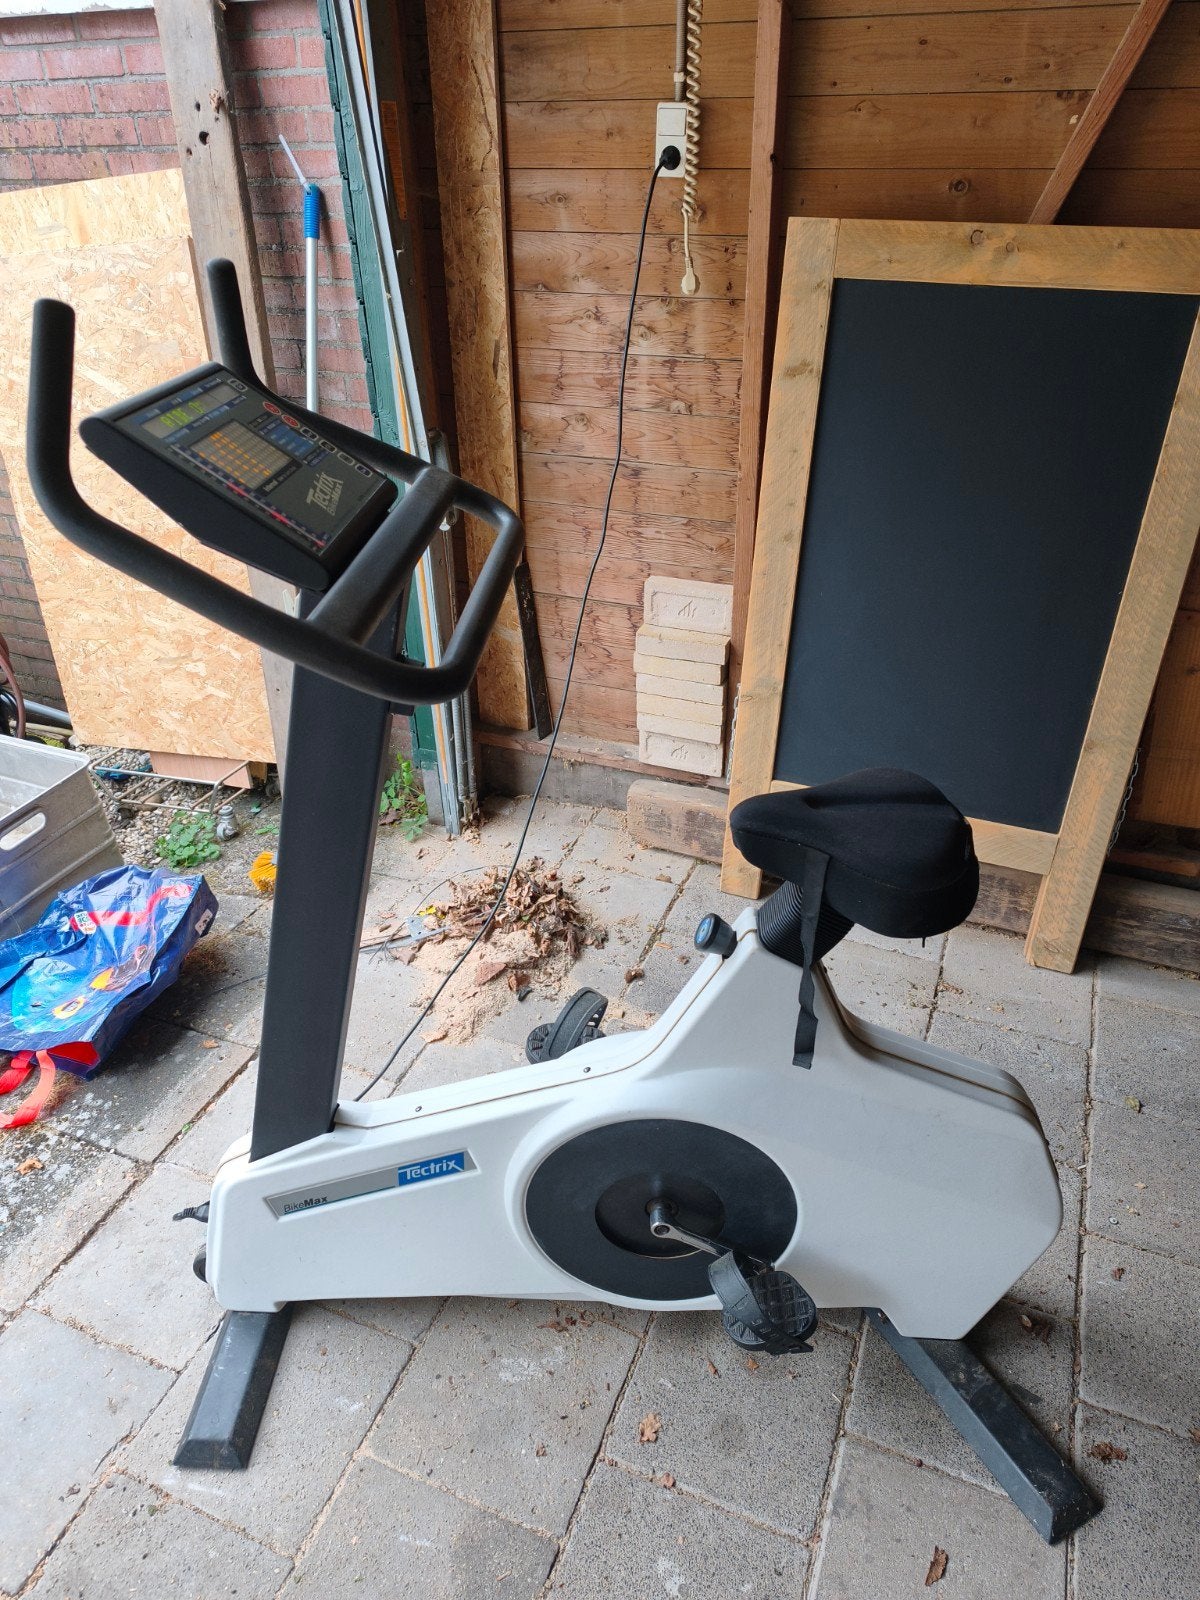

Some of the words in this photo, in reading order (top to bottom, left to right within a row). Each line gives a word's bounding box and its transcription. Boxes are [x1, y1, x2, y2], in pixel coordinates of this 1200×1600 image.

[306, 472, 344, 509] Tectrix
[284, 1196, 328, 1213] BikeMax
[398, 1158, 464, 1180] Tectrix
